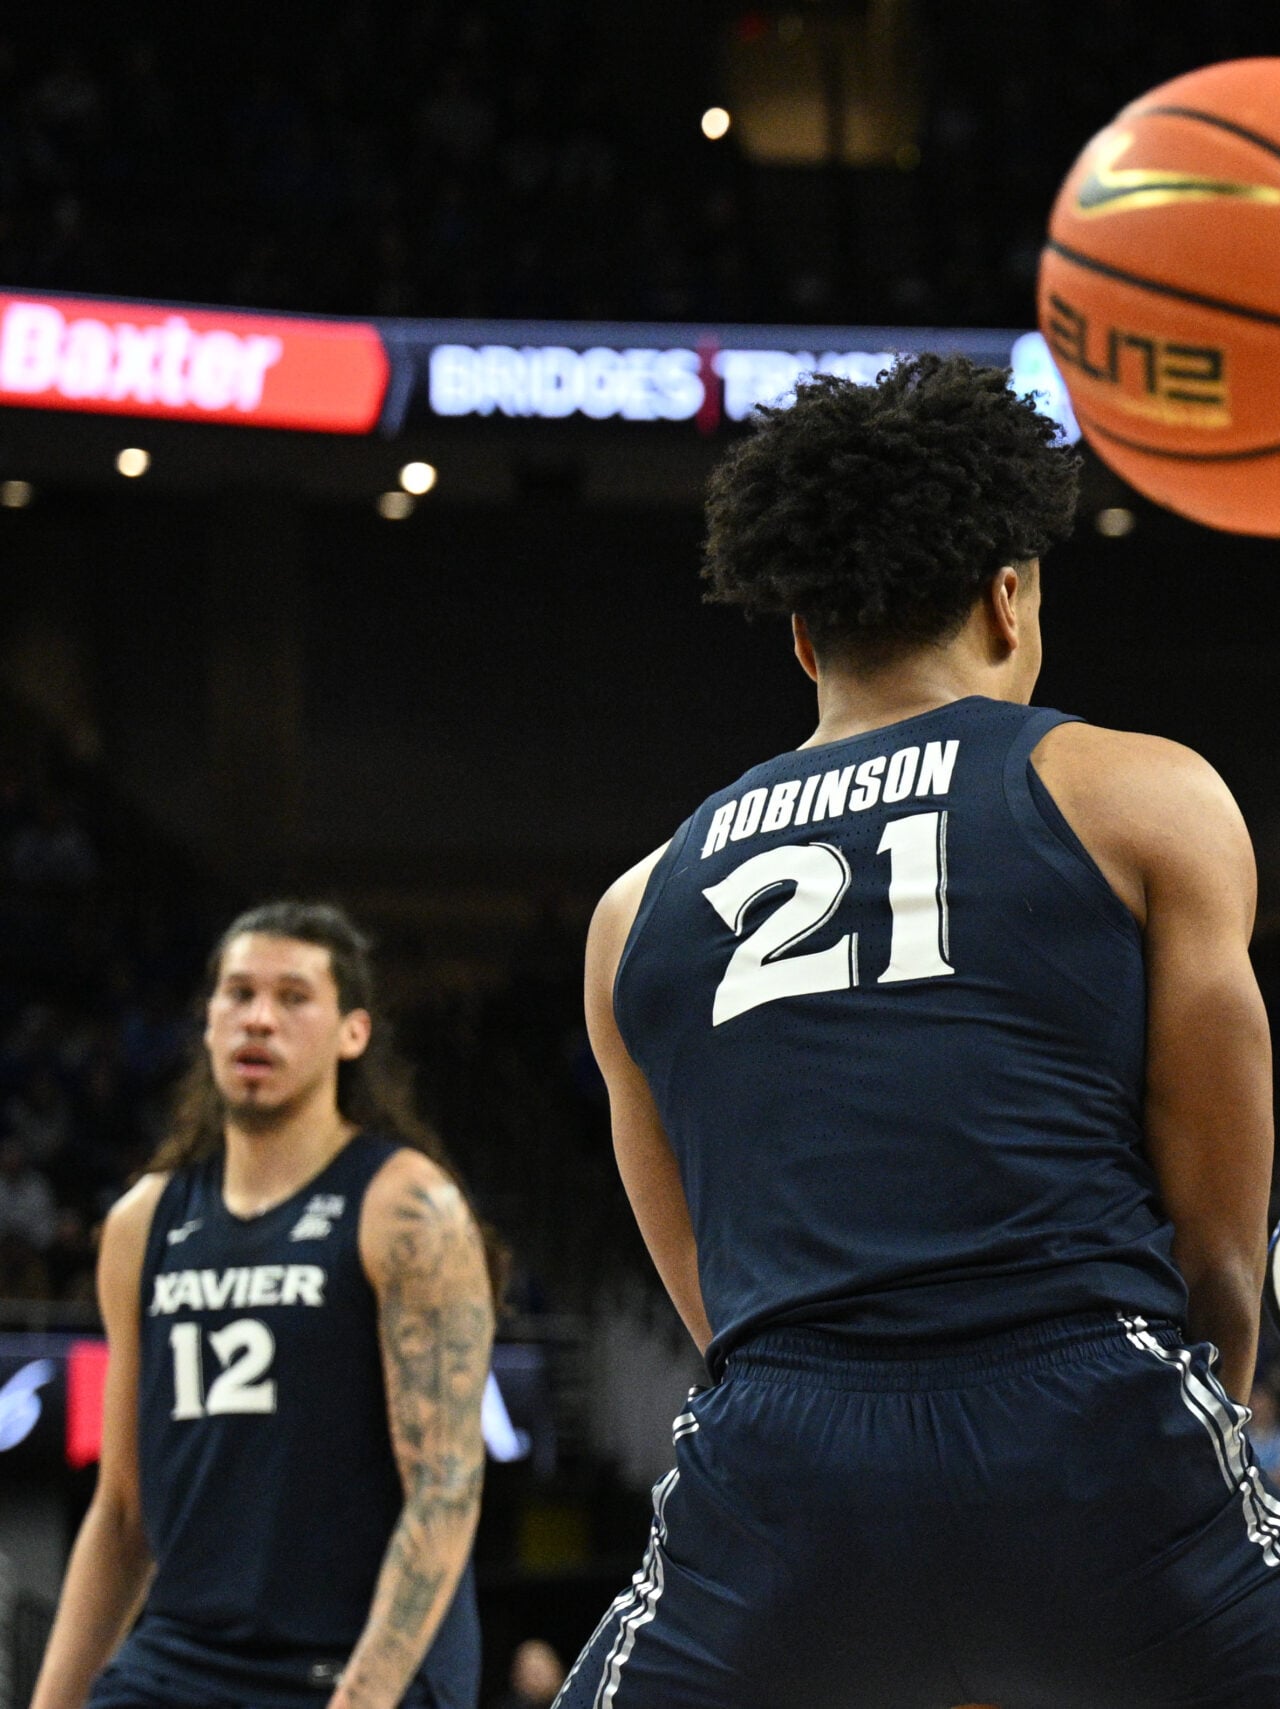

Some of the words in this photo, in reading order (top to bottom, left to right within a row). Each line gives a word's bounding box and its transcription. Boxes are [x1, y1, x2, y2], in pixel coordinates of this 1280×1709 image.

[0, 302, 283, 411] Baxter
[429, 344, 704, 421] BRIDGES
[701, 740, 960, 860] ROBINSON
[702, 810, 955, 1027] 21
[150, 1264, 328, 1317] XAVIER
[170, 1318, 278, 1421] 12
